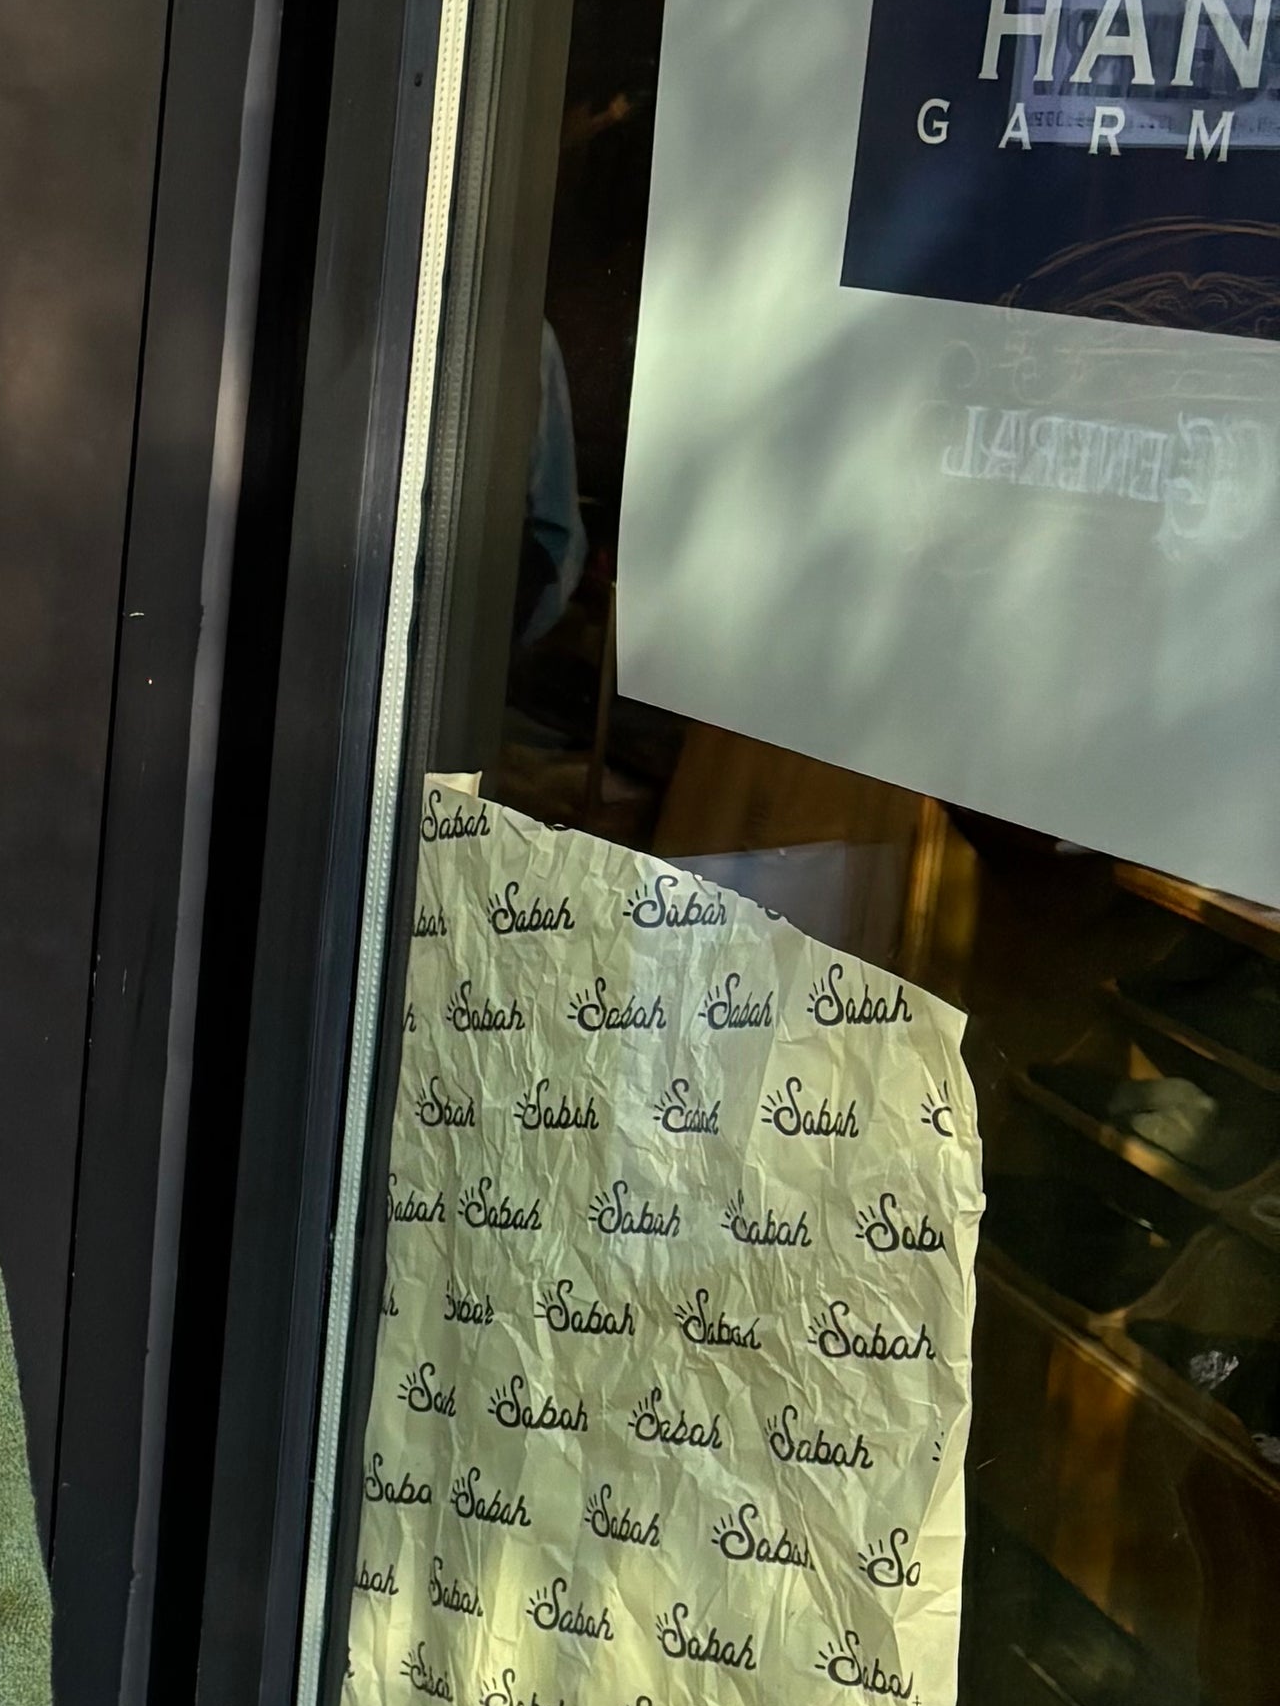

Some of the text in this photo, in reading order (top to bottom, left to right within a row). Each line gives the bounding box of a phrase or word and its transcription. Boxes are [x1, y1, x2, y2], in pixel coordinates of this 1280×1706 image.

[916, 97, 1236, 163] GARM
[421, 790, 490, 842] Sabah
[491, 881, 575, 935] Sabah
[632, 875, 727, 928] Sabah
[452, 980, 525, 1032] Sabah
[577, 977, 666, 1032] Sabah
[708, 972, 773, 1030] Sabah
[814, 963, 912, 1026] Sabah
[522, 1078, 599, 1130] Sabah
[773, 1076, 859, 1138] Sabah
[464, 1176, 543, 1230] Sabah
[597, 1180, 680, 1238] Sabah
[546, 1279, 635, 1336] Sabah
[683, 1289, 762, 1350] Sabah
[818, 1300, 936, 1360] Sabah
[496, 1375, 588, 1432] Sabah
[635, 1387, 723, 1450] Sabah
[770, 1405, 873, 1469] Sabah
[365, 1453, 433, 1505] Saba
[454, 1467, 531, 1527] Sabah
[591, 1484, 660, 1547] Sabah
[534, 1578, 614, 1641] Sabah
[660, 1603, 756, 1670] Sabah
